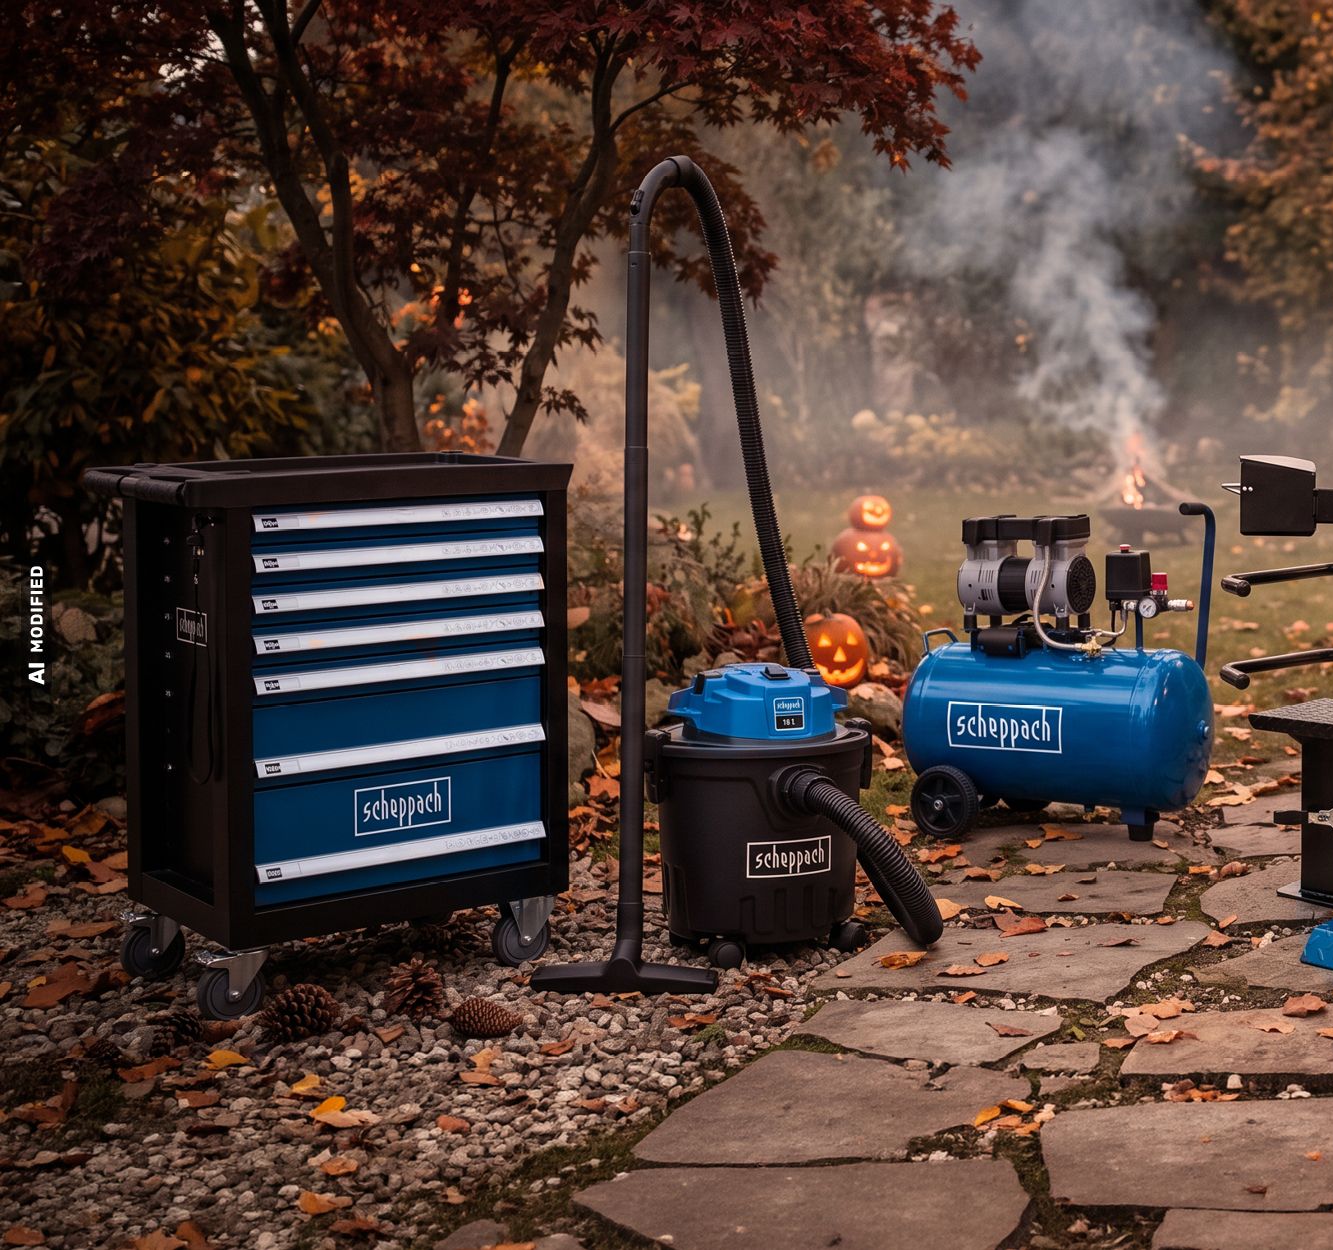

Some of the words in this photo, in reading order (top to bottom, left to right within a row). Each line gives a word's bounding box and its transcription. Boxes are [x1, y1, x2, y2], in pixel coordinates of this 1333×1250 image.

[957, 704, 1051, 748] scheppach
[363, 781, 441, 827] scheppach
[755, 839, 825, 874] scheppach
